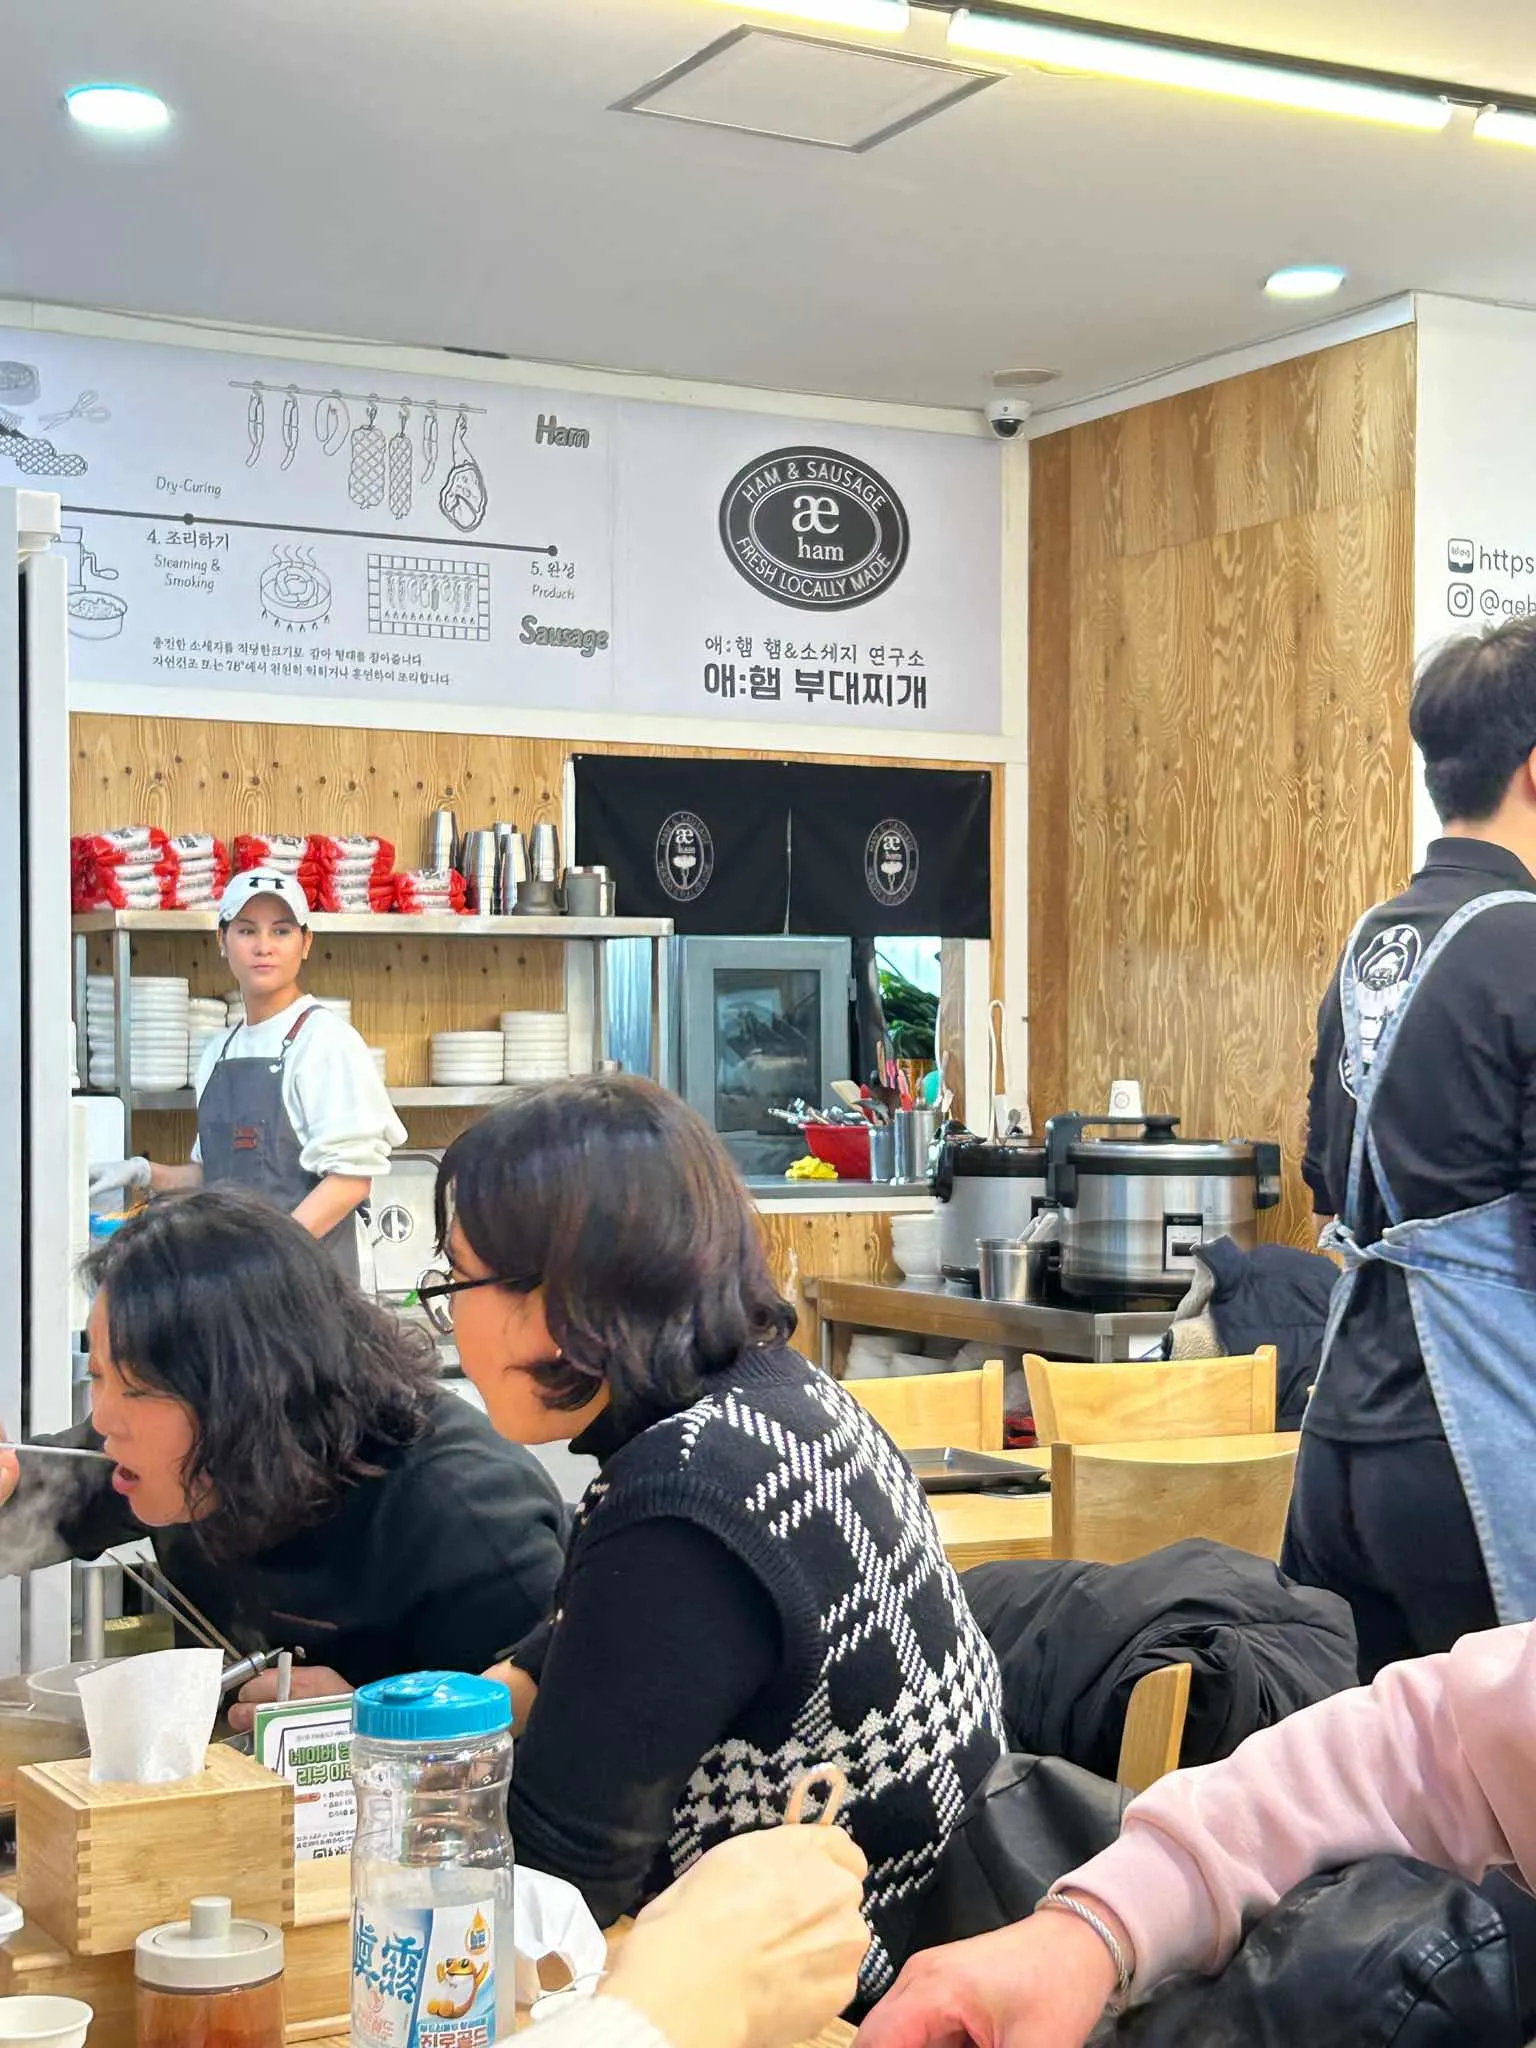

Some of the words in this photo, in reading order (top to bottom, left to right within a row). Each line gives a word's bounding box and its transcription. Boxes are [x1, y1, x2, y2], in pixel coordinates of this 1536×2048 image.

[535, 413, 590, 449] Ham
[155, 475, 223, 499] Dry-Curing
[742, 467, 782, 503] HAM
[787, 462, 800, 480] &
[807, 461, 887, 512] SAUSAGE
[146, 528, 161, 545] 4.
[165, 529, 230, 552] 조리하기
[797, 536, 845, 562] ham
[154, 554, 208, 573] Steaming
[211, 558, 221, 571] &
[736, 536, 778, 584] FRESH
[779, 572, 846, 597] LOCALLY
[849, 552, 891, 592] MADE
[164, 573, 215, 594] Smoking
[519, 614, 609, 658] Sausage
[704, 635, 753, 659] 애:햄
[868, 645, 926, 667] 연구소
[794, 668, 927, 709] 부대찌개
[288, 1743, 336, 1767] 네이버
[296, 1764, 328, 1786] 리뷰
